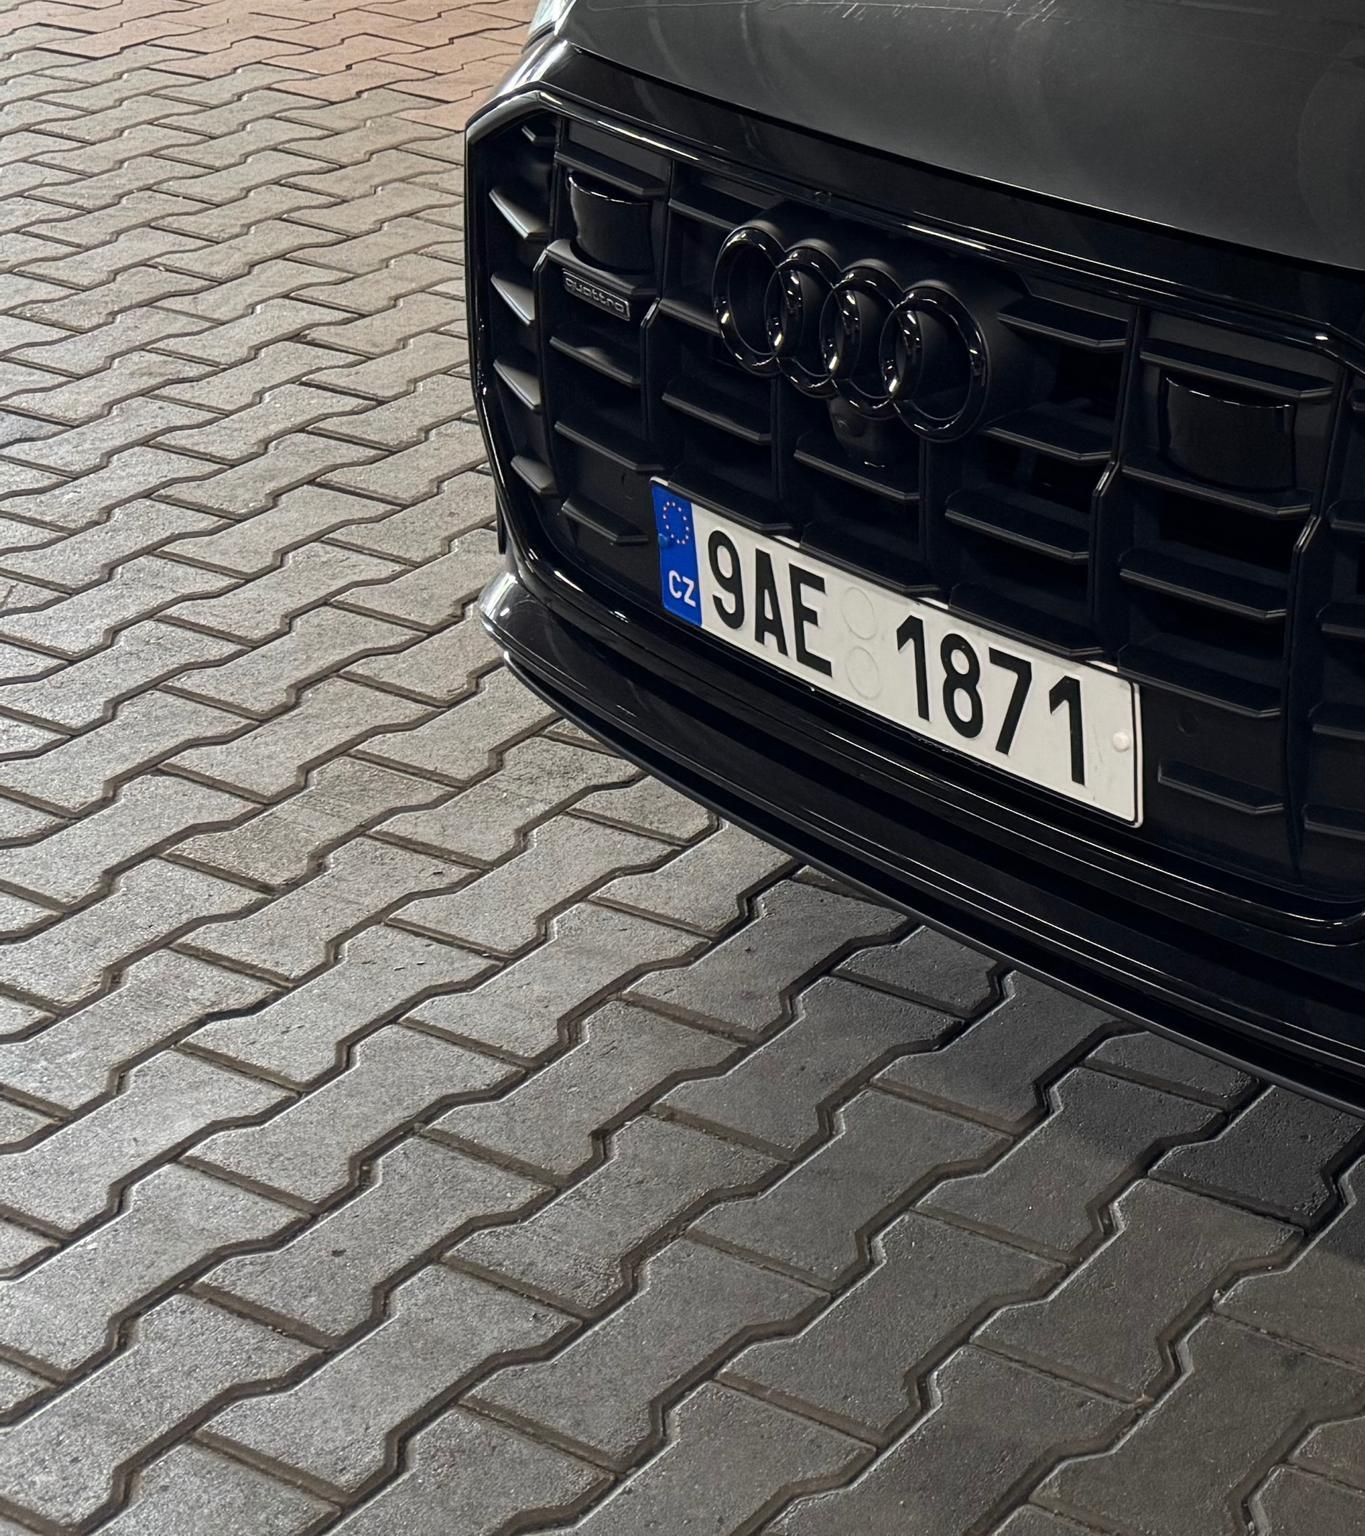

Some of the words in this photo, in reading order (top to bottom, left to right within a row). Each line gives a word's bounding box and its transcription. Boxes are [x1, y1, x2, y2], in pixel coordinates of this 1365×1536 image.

[564, 276, 626, 314] quattro
[668, 569, 697, 609] CZ
[707, 529, 833, 678] 9AE
[895, 614, 1086, 786] 1871
